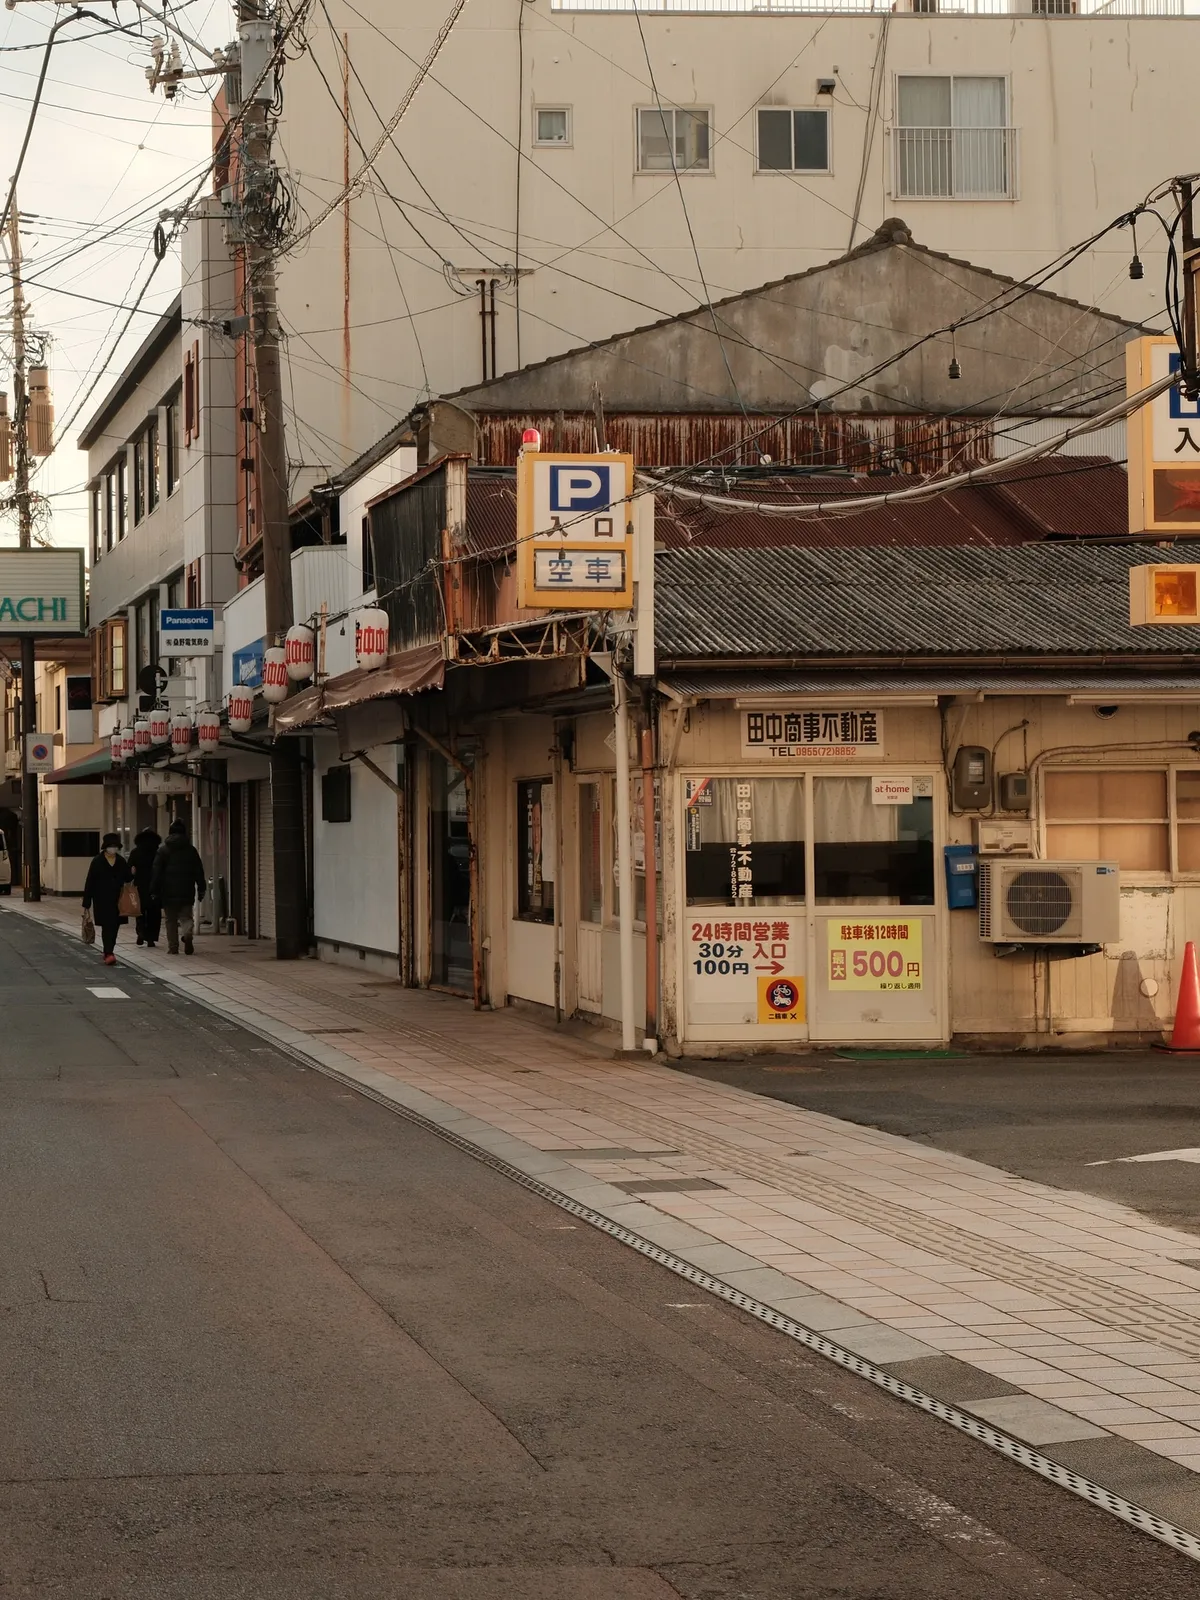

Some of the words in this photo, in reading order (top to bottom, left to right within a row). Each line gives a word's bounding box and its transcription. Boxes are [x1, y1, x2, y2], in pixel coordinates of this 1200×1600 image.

[558, 469, 601, 508] P
[546, 516, 613, 538] 入口
[548, 557, 611, 583] 空車
[166, 616, 209, 625] Panasonic
[747, 711, 877, 743] 田中商事不動産
[737, 784, 753, 898] 田中商事不動産
[691, 921, 790, 941] 24時間営業
[841, 924, 909, 940] 駐車後12時間
[698, 943, 744, 958] 30分
[752, 943, 786, 959] 入口
[693, 960, 749, 975] 100円
[832, 951, 845, 978] 最大
